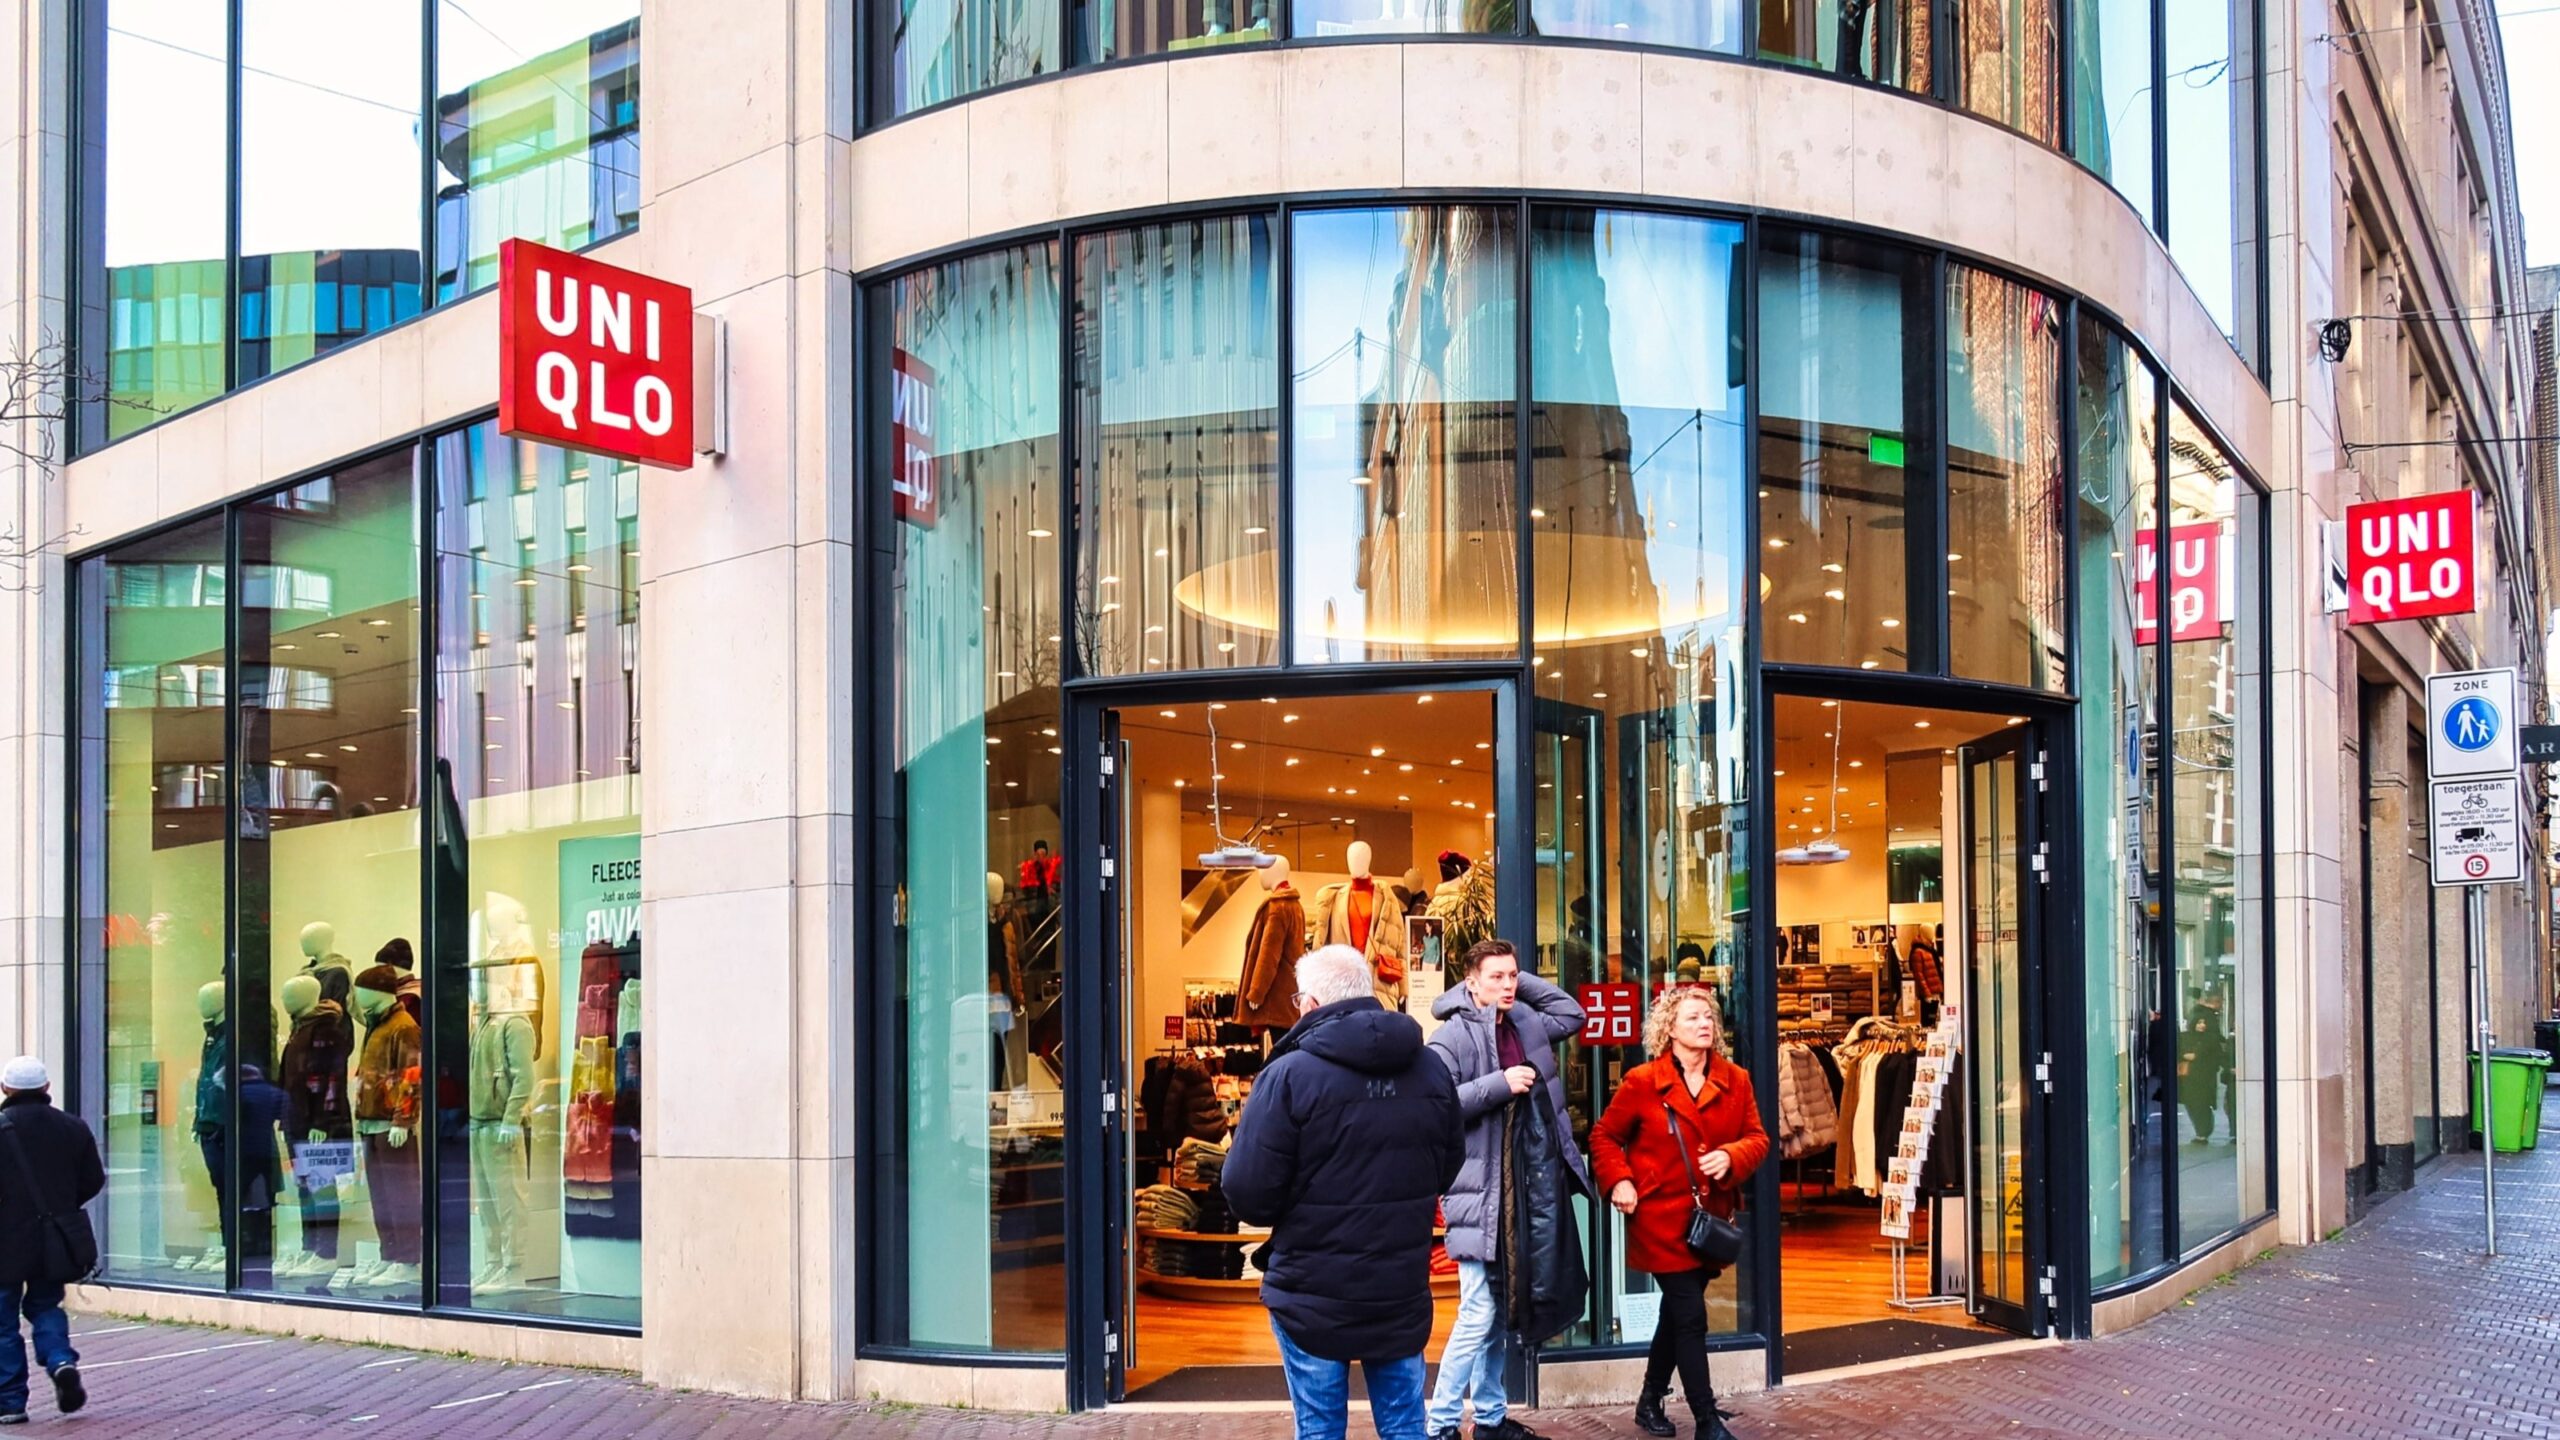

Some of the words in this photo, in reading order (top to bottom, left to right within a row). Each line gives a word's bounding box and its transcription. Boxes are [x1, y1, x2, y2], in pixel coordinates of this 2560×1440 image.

[536, 269, 660, 362] UNI
[536, 351, 673, 437] QLO
[2361, 508, 2449, 557] UNI
[2362, 557, 2461, 613] QLO
[2453, 679, 2489, 692] ZONE
[2443, 782, 2506, 795] toegestaan:
[592, 859, 641, 884] FLEECE
[2470, 861, 2483, 871] 15
[601, 890, 615, 903] Just
[617, 892, 625, 901] as
